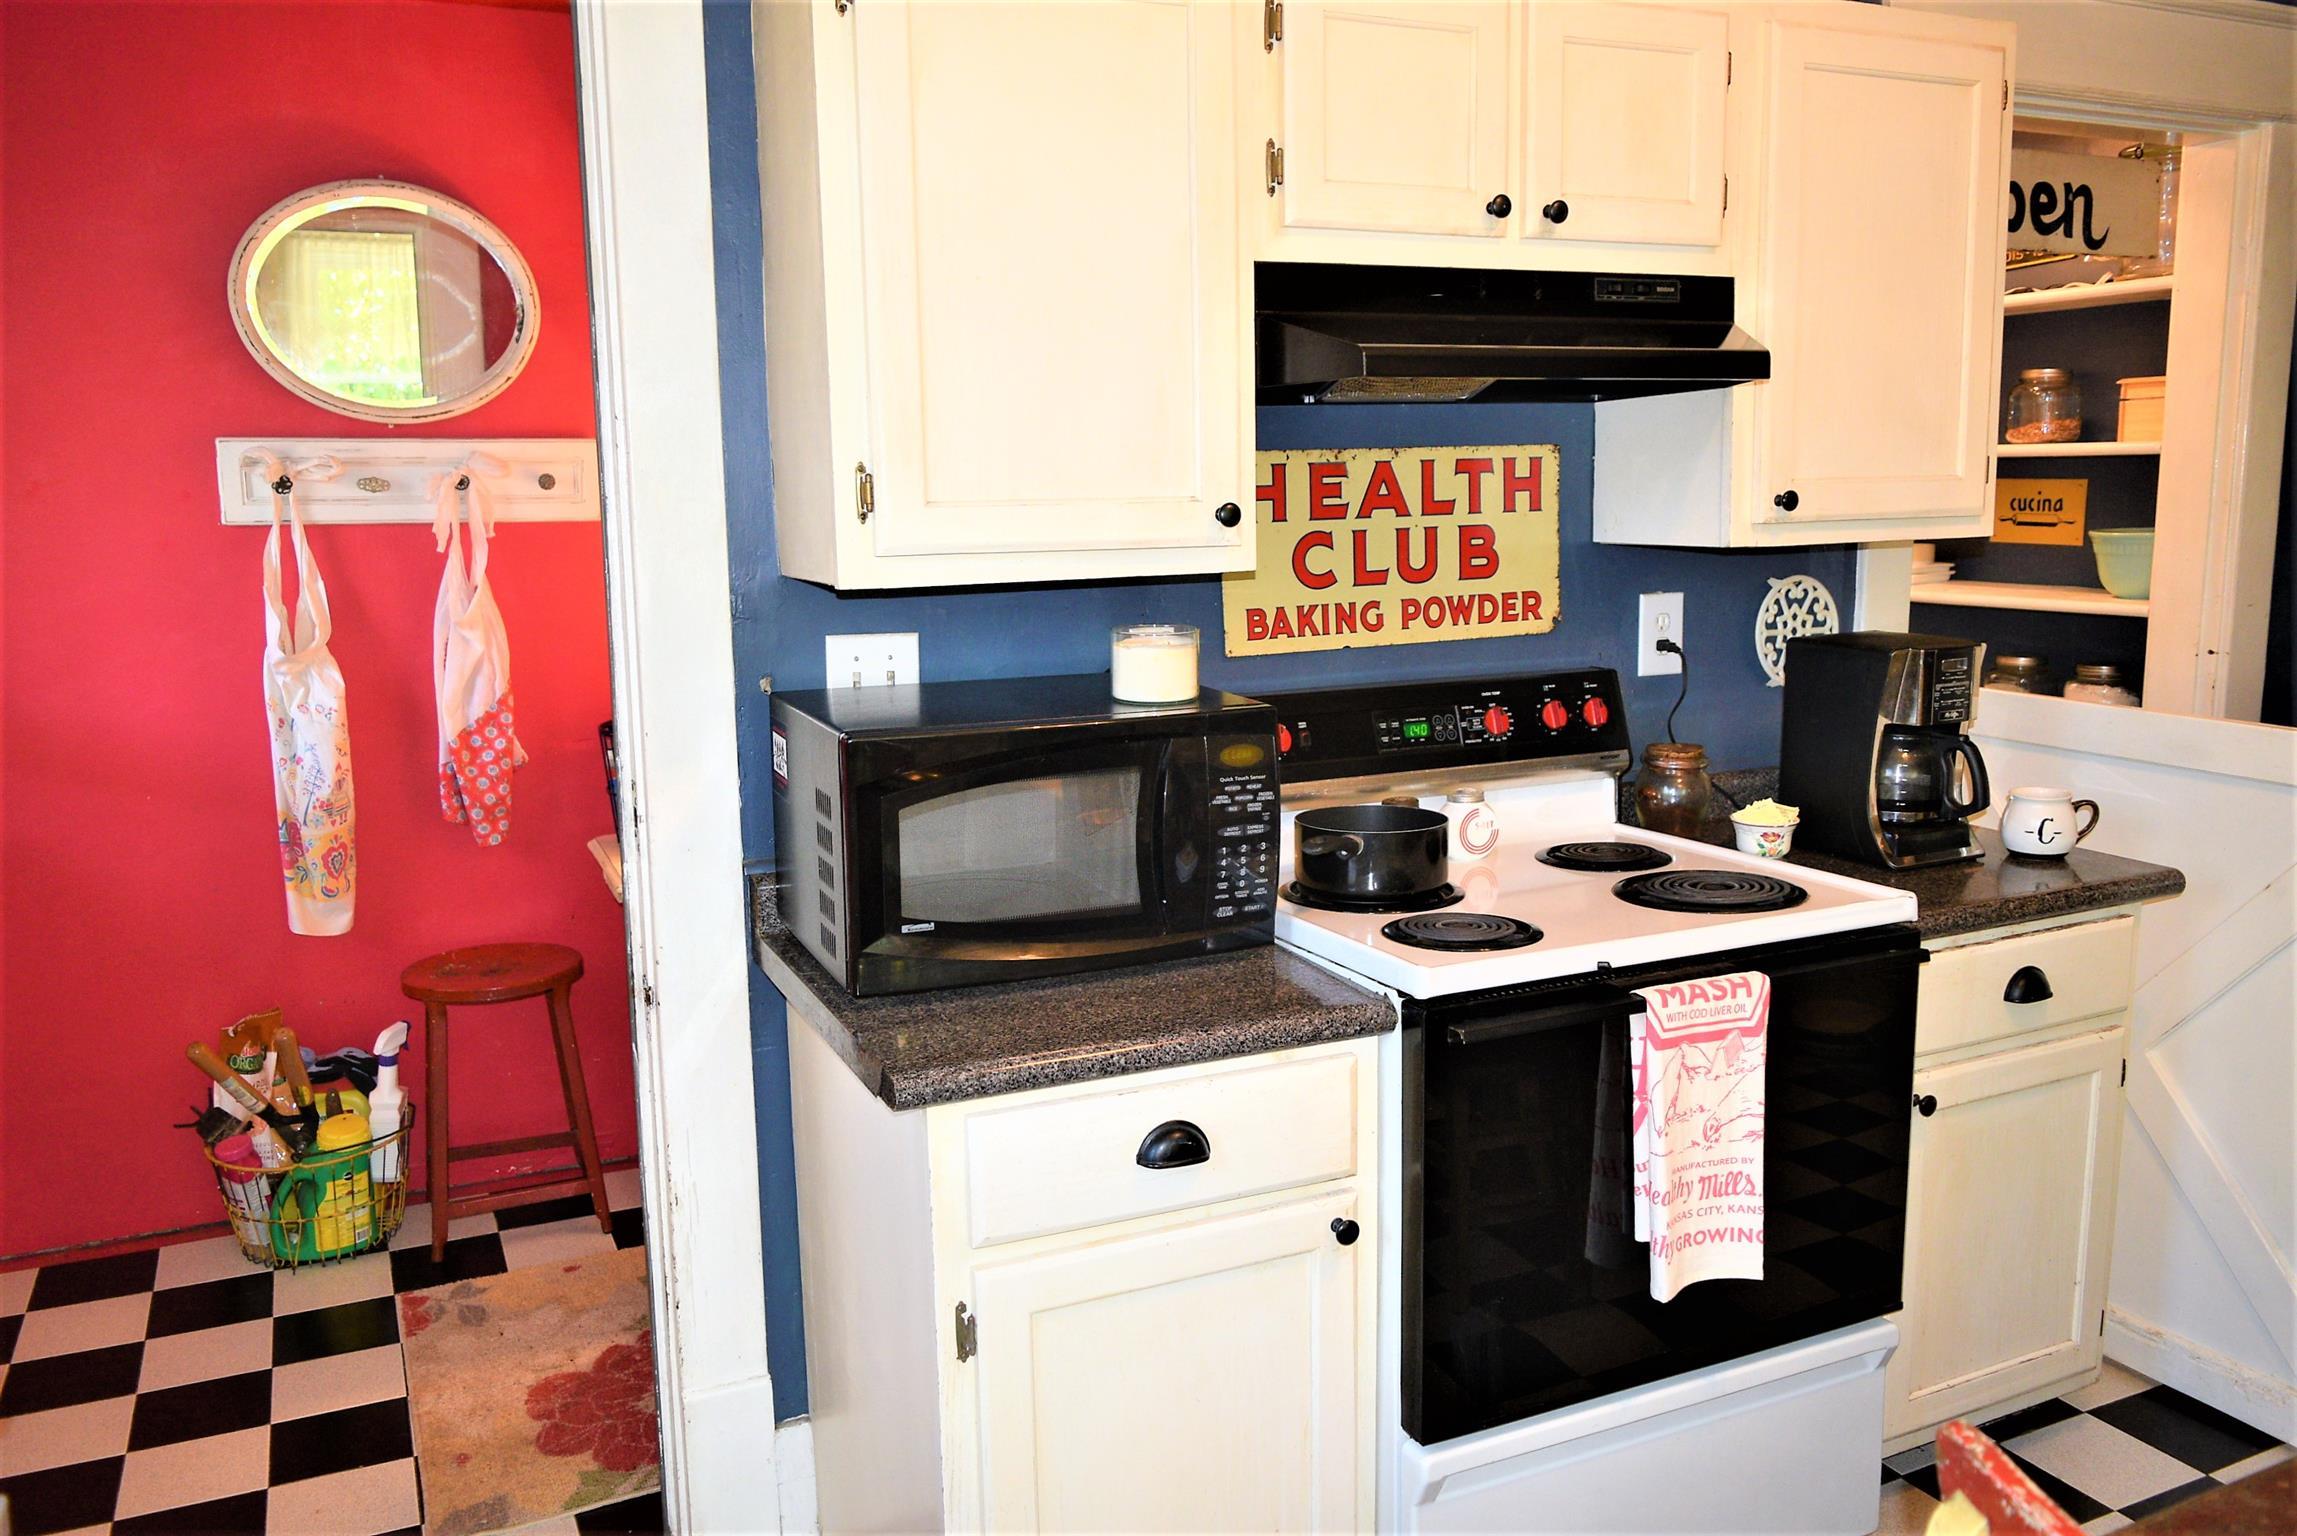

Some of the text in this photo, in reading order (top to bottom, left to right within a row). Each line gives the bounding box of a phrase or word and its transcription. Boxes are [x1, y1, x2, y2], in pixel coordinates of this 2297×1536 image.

[1256, 456, 1543, 523] HEALTH
[2009, 490, 2064, 512] cucina
[1291, 523, 1500, 590] CLUB
[1246, 590, 1544, 641] BAKING POWDER
[1654, 975, 1753, 1008] MASH
[1666, 1003, 1748, 1023] WITH COD LIVER OIL
[1741, 1156, 1755, 1165] BY
[1696, 1204, 1724, 1218] CITY,
